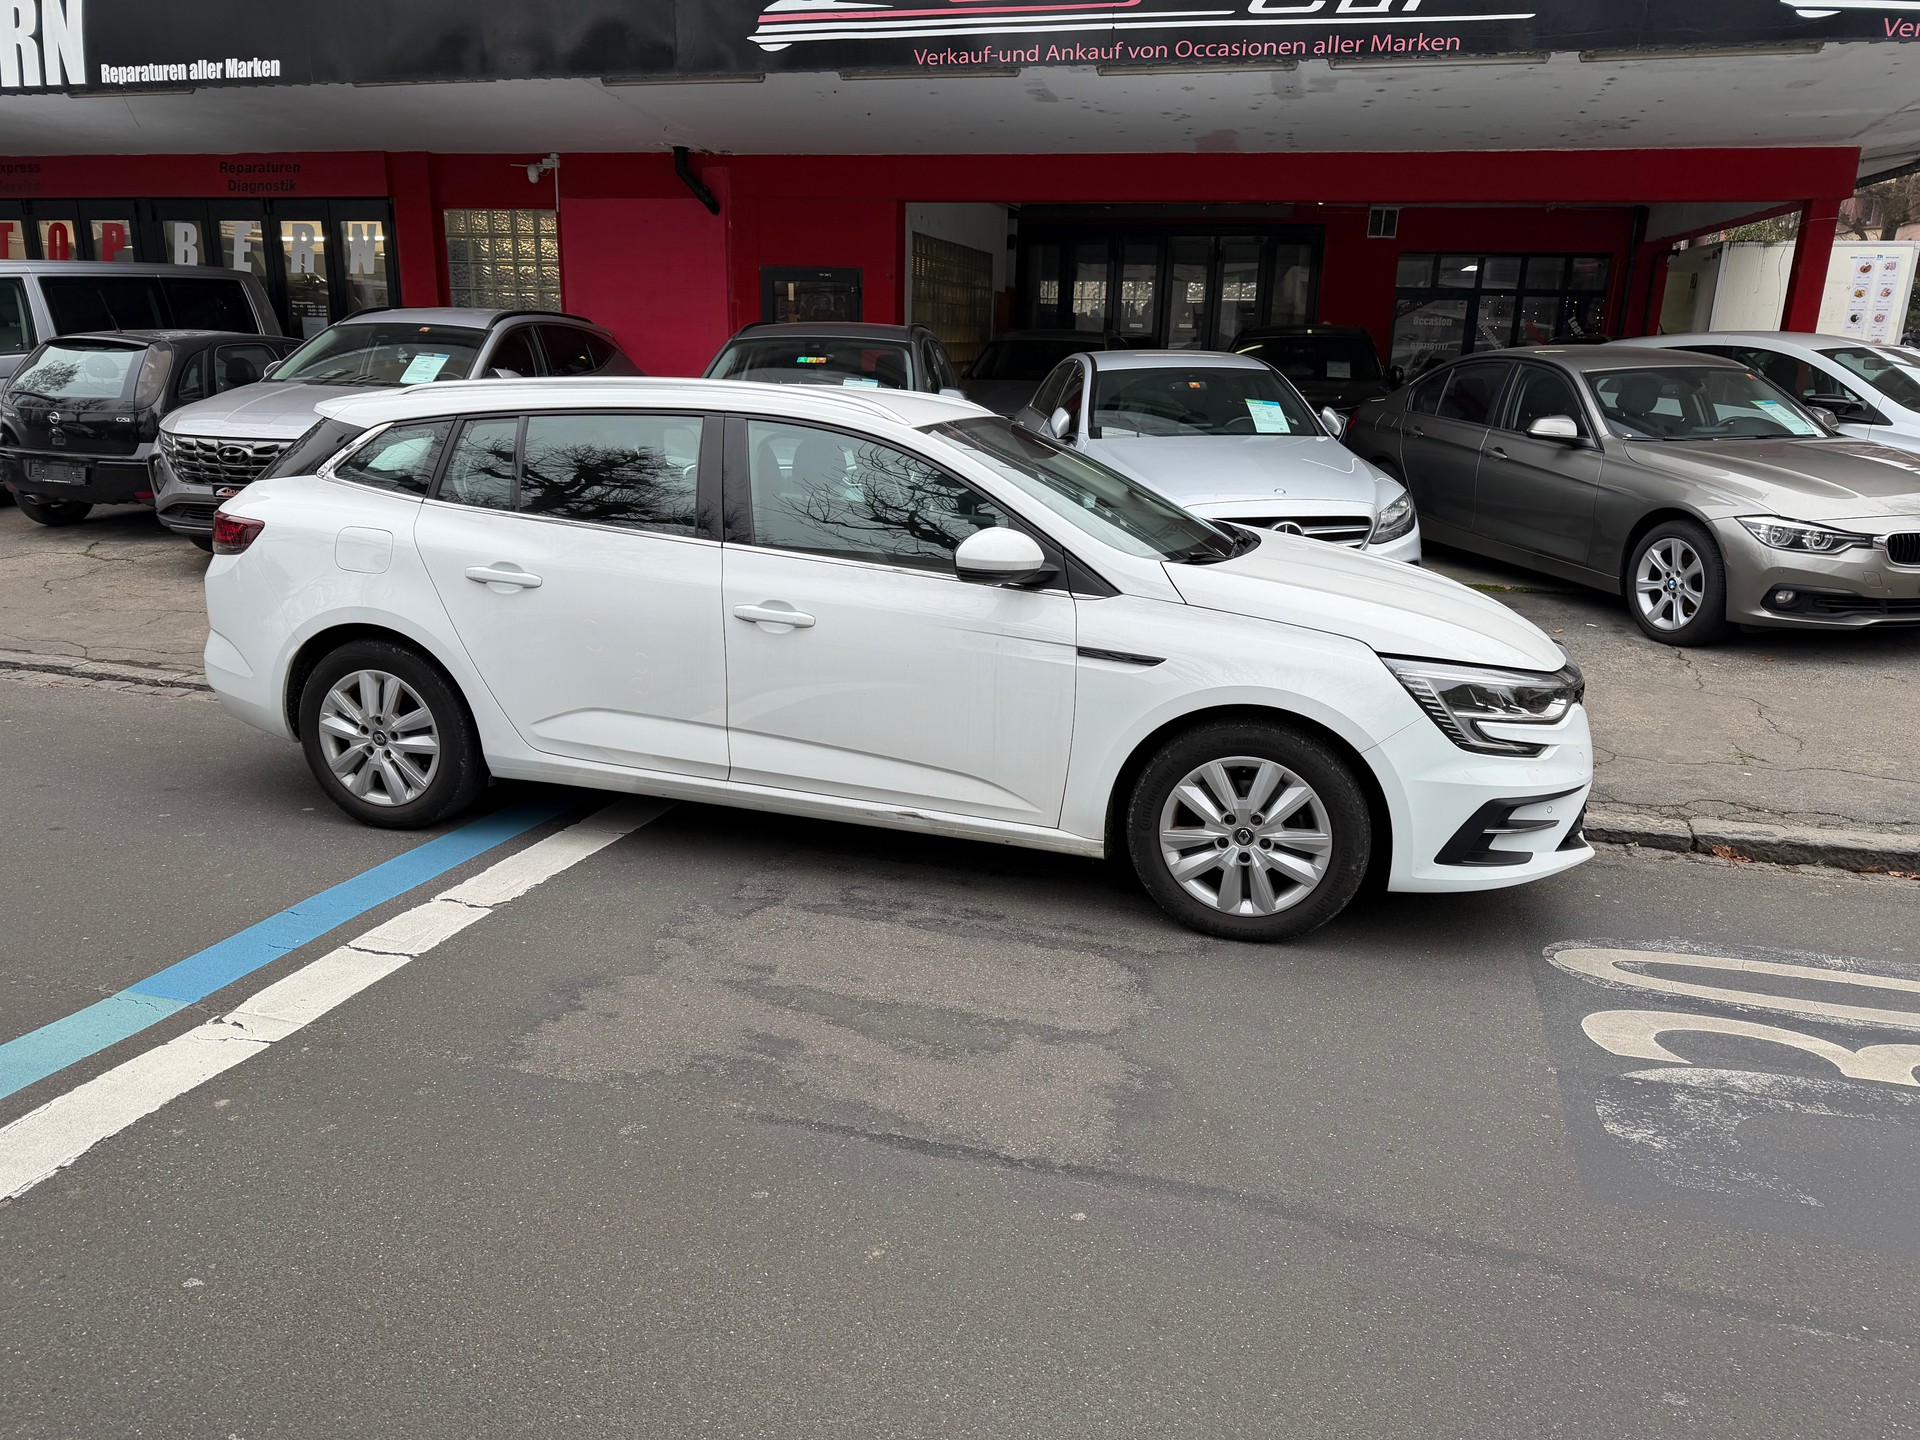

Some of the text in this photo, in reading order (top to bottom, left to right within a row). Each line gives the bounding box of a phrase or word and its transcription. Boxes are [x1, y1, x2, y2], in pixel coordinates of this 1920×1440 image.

[1046, 42, 1124, 61] Ankauf
[1128, 42, 1168, 58] von
[1175, 37, 1307, 58] Occasionen
[1315, 36, 1364, 54] aller
[1371, 32, 1461, 54] Marken
[101, 57, 281, 84] Reparaturen aller Marken
[219, 161, 301, 175] Reparaturen
[227, 179, 297, 194] Diagnostik
[0, 221, 376, 275] TOP BERN
[1412, 316, 1453, 327] Occasion
